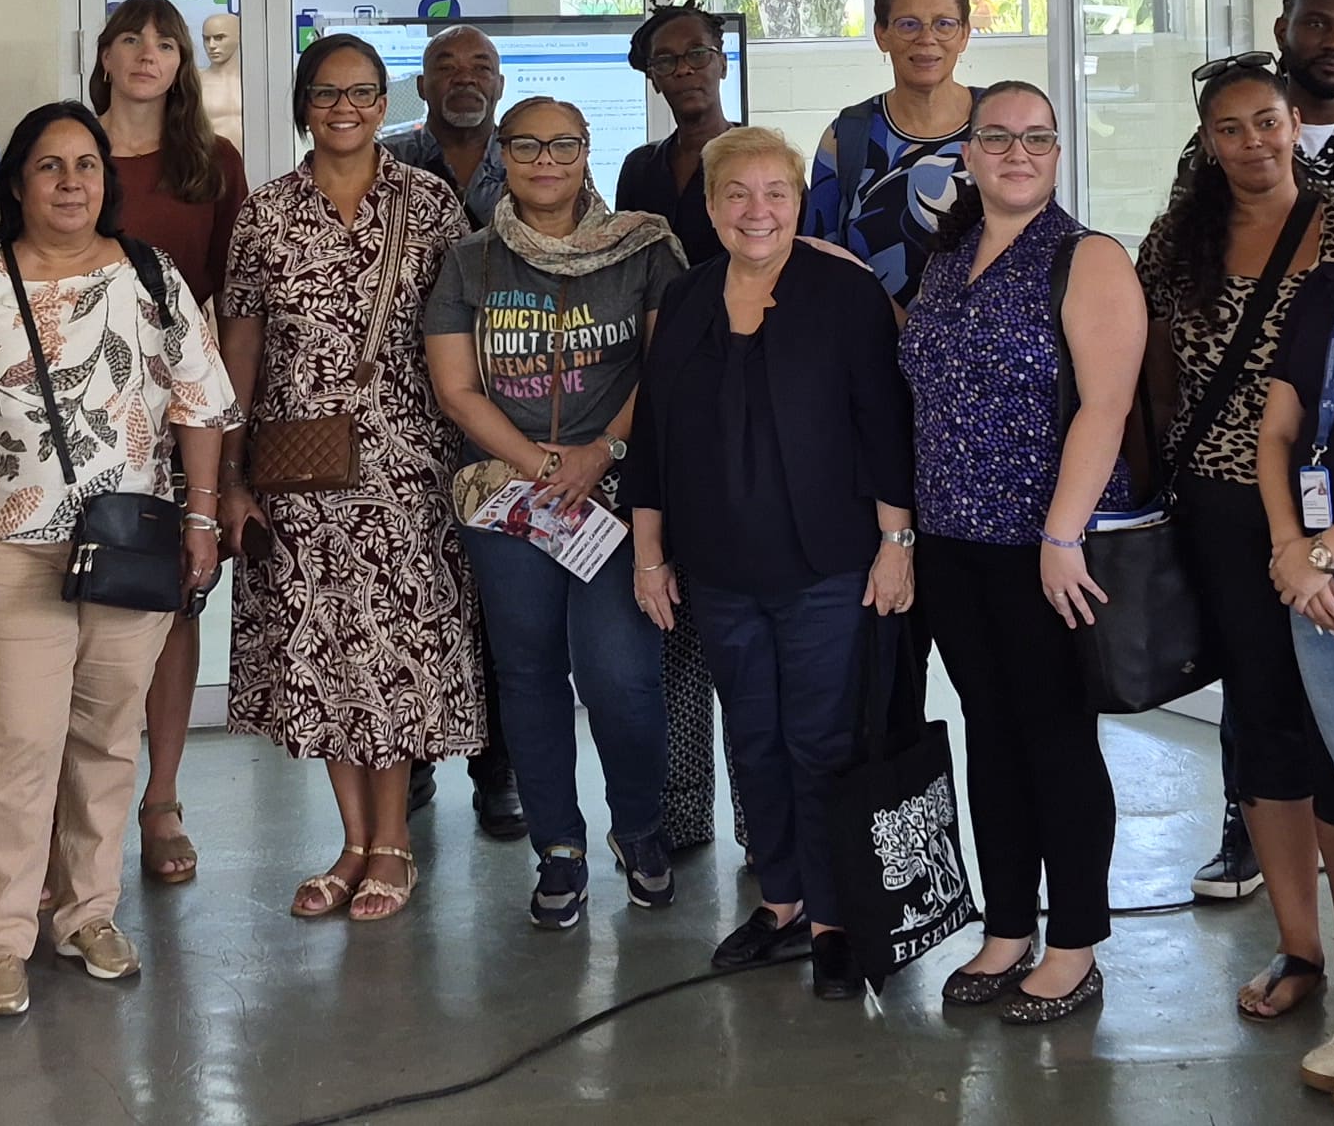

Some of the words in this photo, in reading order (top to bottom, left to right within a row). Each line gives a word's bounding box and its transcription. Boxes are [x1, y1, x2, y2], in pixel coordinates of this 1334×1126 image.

[543, 292, 556, 312] A
[490, 485, 522, 509] ITCA
[892, 893, 974, 964] ELSEVIER
